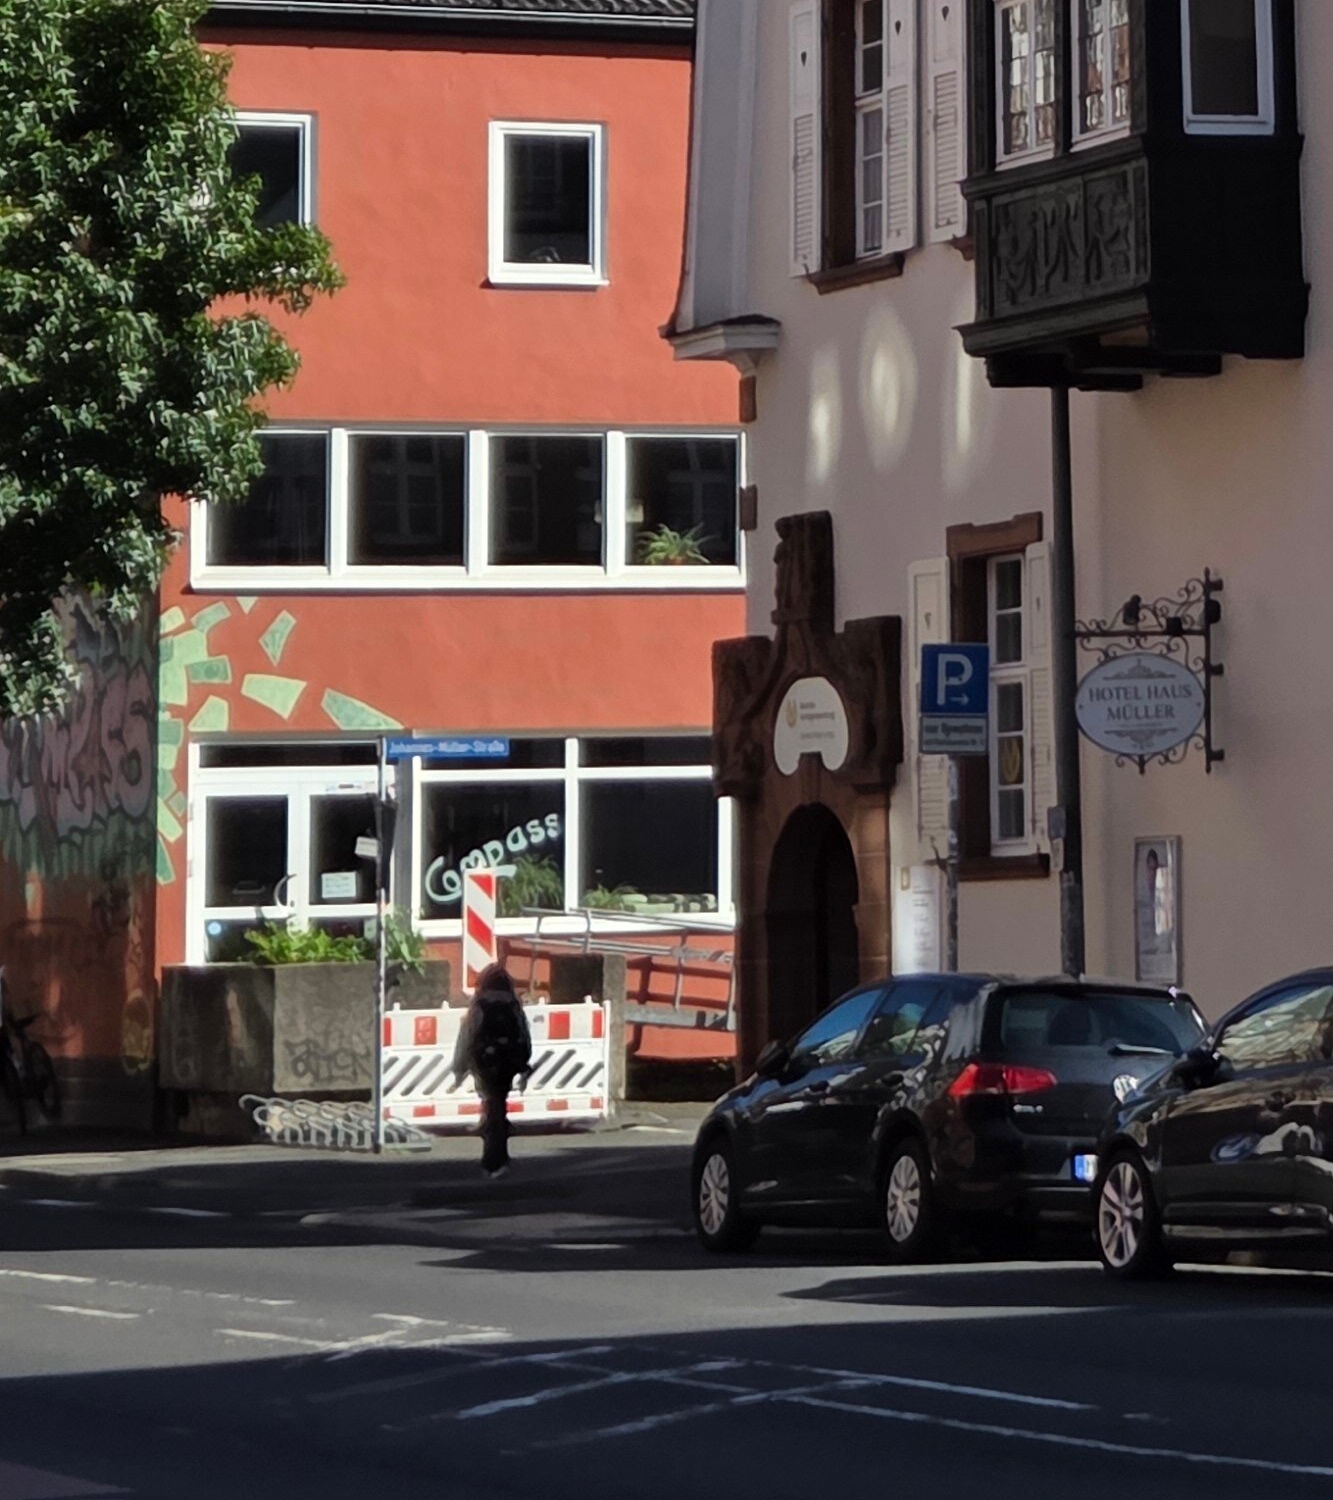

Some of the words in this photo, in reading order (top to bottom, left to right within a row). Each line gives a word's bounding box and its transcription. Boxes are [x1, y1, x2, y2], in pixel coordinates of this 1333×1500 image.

[937, 653, 973, 706] P
[1089, 686, 1143, 702] HOTEL
[1147, 684, 1192, 700] HAUS
[1106, 703, 1175, 721] MÜLLER
[425, 813, 560, 902] Compass
